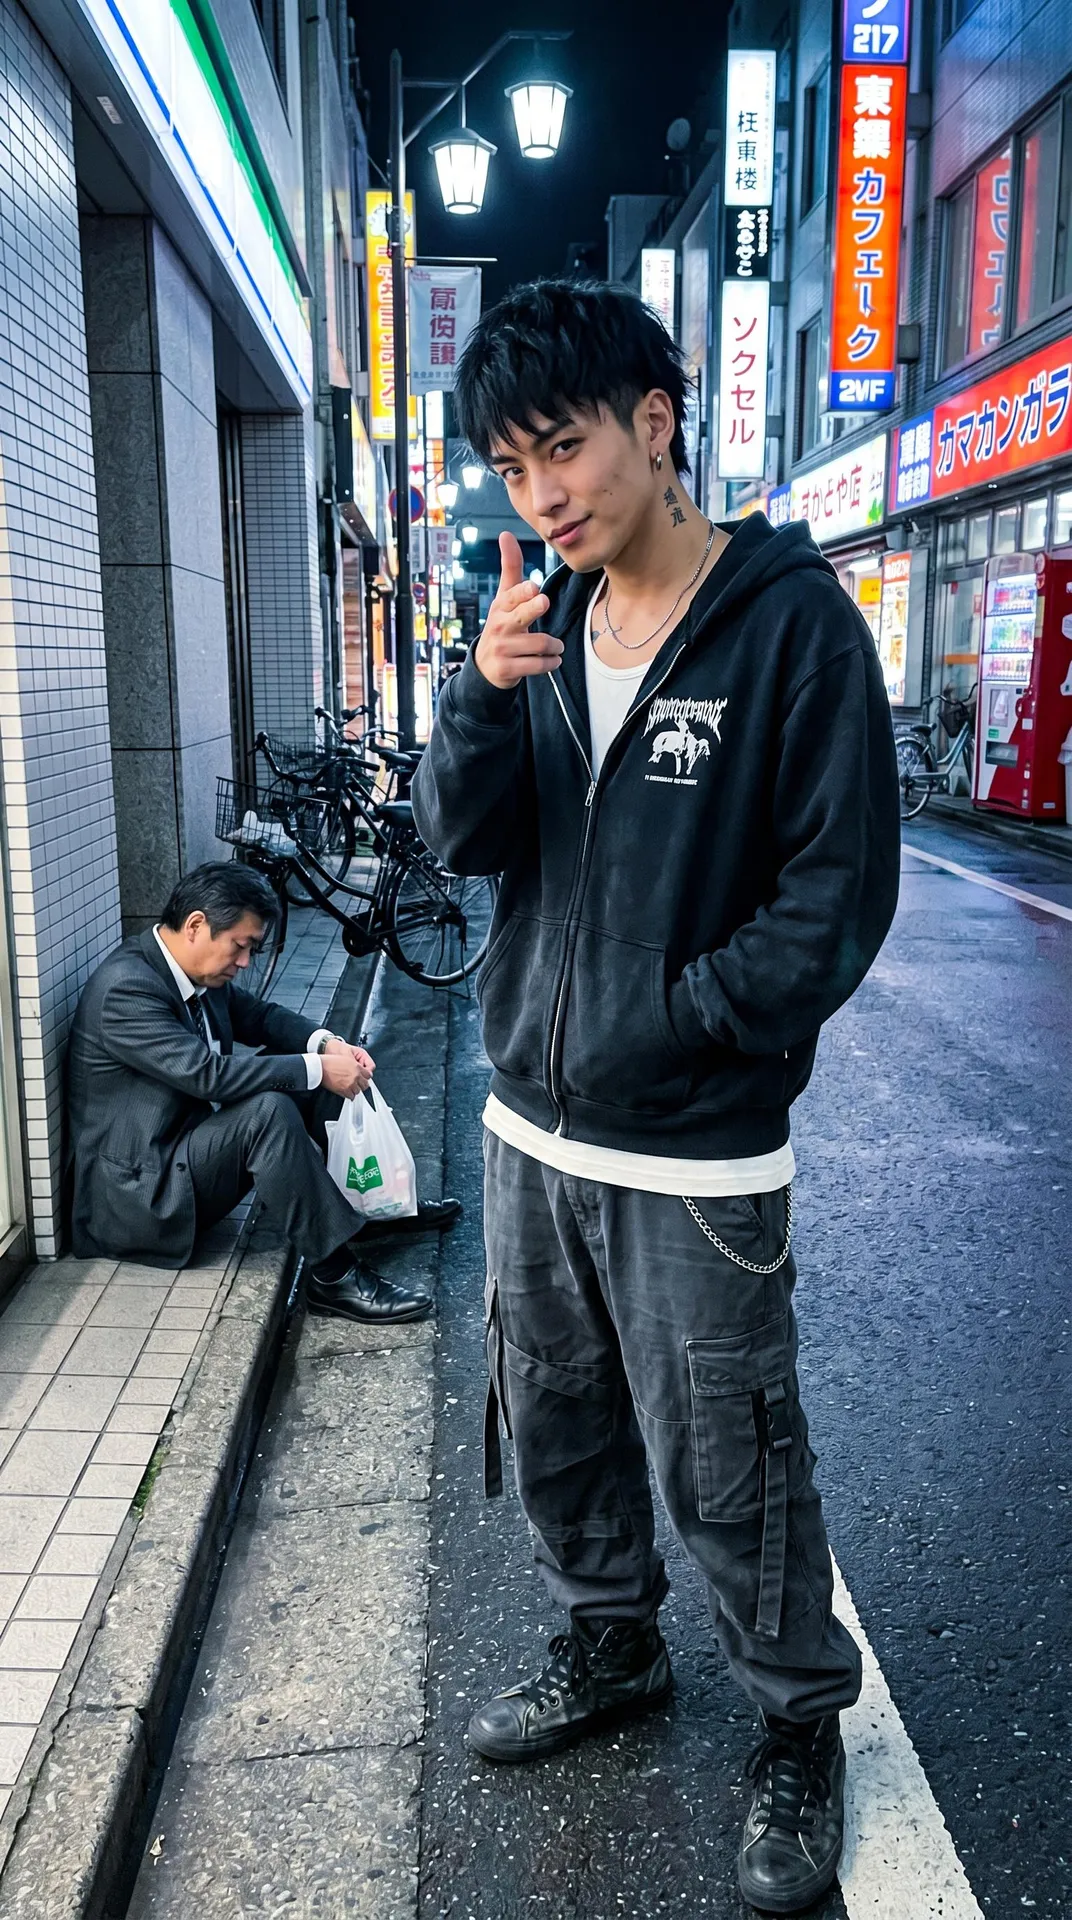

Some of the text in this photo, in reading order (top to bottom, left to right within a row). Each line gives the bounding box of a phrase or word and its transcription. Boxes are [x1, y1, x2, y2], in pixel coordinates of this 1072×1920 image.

[853, 24, 899, 54] 217
[729, 317, 758, 444] ソクセル
[936, 363, 1072, 478] カマカンガラ
